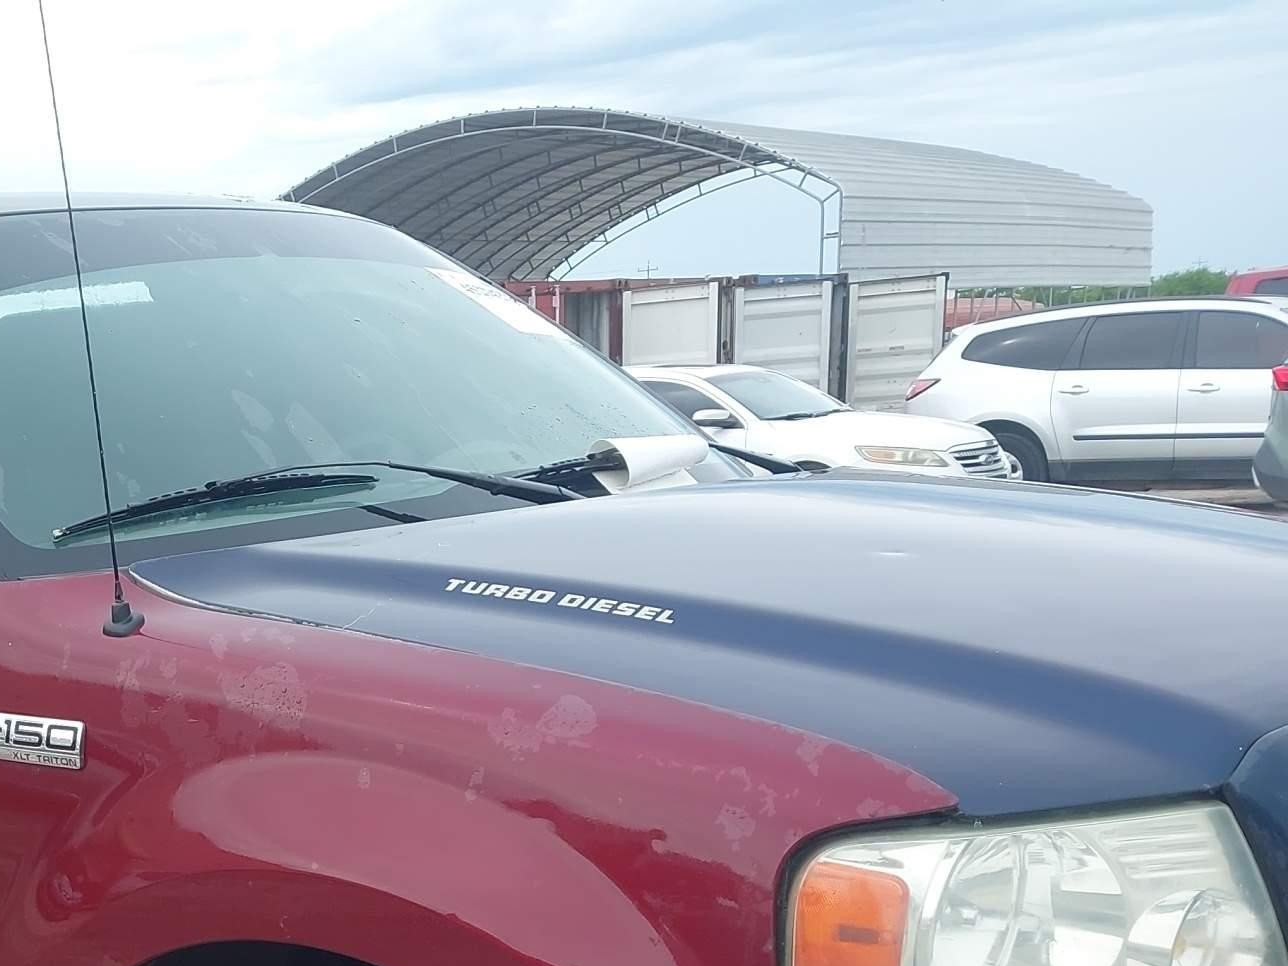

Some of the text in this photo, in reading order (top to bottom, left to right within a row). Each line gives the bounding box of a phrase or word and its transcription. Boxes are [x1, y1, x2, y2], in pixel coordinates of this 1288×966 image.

[445, 578, 675, 624] TURBO DIESEL
[12, 751, 79, 768] XLT TRITON
